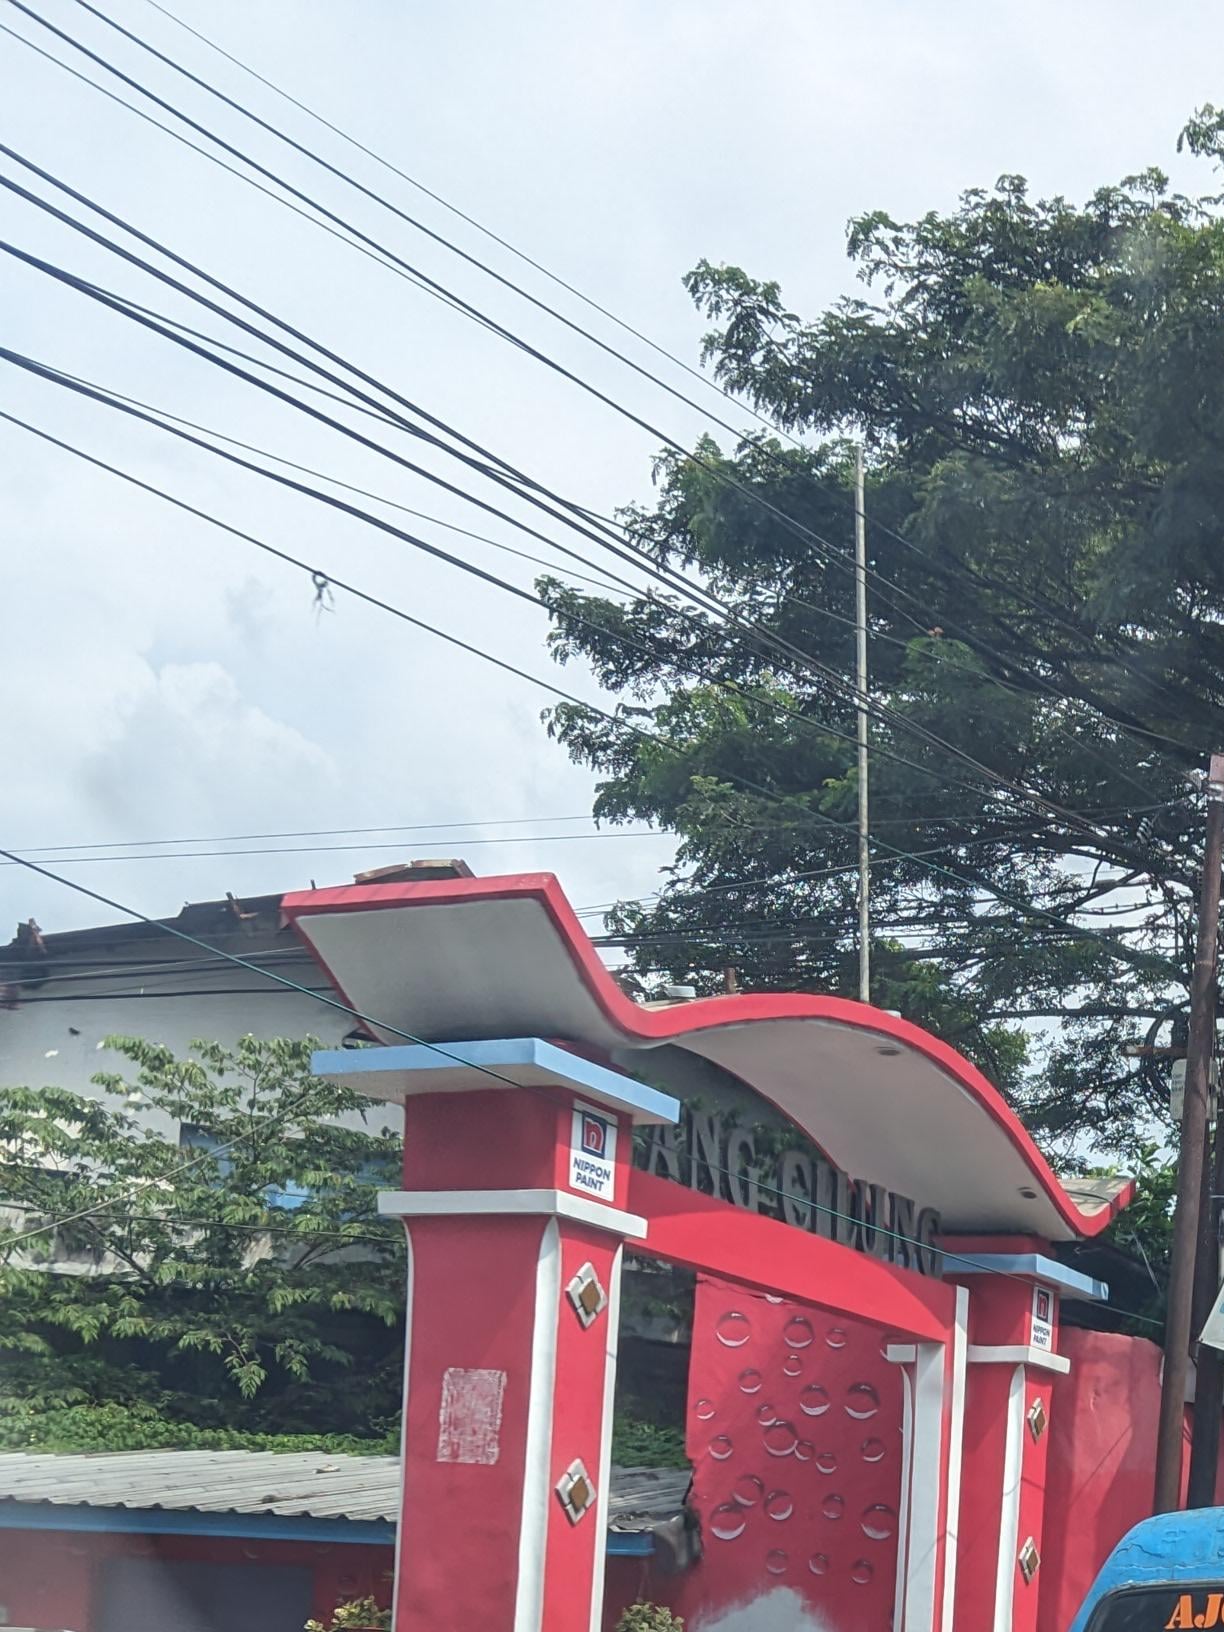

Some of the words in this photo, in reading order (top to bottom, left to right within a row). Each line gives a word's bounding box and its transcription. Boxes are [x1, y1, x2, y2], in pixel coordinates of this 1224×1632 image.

[573, 1157, 611, 1181] NIPPON
[640, 1106, 759, 1214] ANG
[575, 1172, 604, 1191] PAINT
